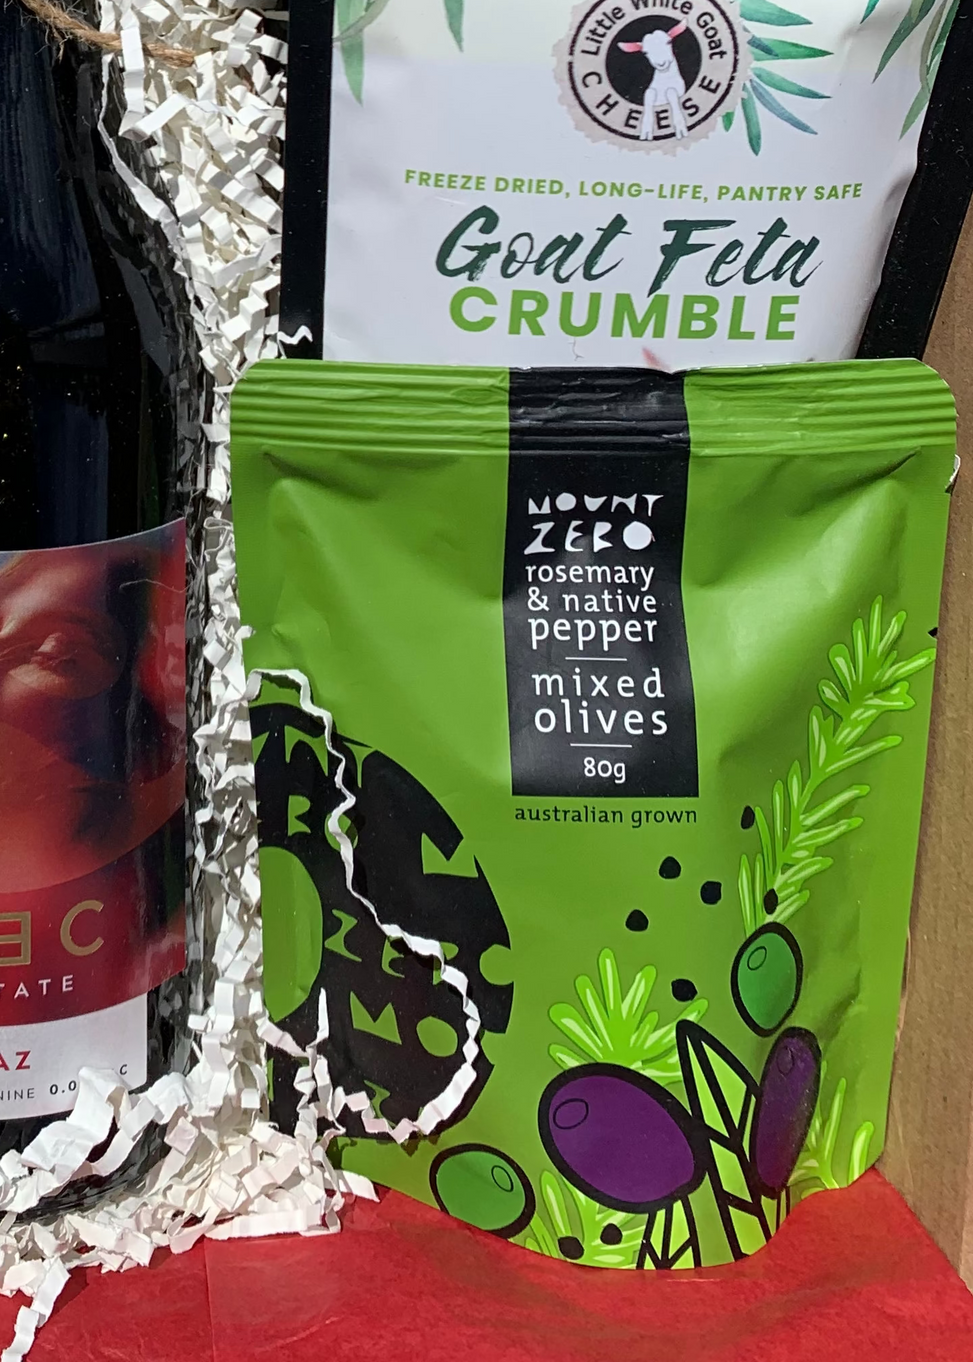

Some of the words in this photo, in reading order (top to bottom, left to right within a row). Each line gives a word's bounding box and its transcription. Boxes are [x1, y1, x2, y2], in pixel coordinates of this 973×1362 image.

[581, 6, 625, 56] Little
[696, 11, 728, 60] Goat
[582, 71, 721, 130] CHEESE
[404, 169, 486, 191] FREEZE
[494, 176, 572, 198] DRIED,
[579, 180, 710, 204] LONG-LIFE,
[718, 184, 808, 202] PANTRY
[813, 182, 864, 201] SAFE
[435, 205, 632, 285] Goat
[647, 217, 823, 299] Feta
[448, 286, 801, 342] CRUMBLE
[528, 492, 664, 517] MOUNT
[523, 520, 656, 555] ZERO
[525, 564, 655, 591] rosemary
[527, 586, 549, 612] &
[562, 589, 657, 613] native
[528, 617, 658, 651] pepper
[531, 667, 665, 698] mixed
[534, 698, 668, 735] olives
[583, 756, 627, 784] 80g
[515, 805, 623, 823] australian
[631, 809, 697, 829] grown
